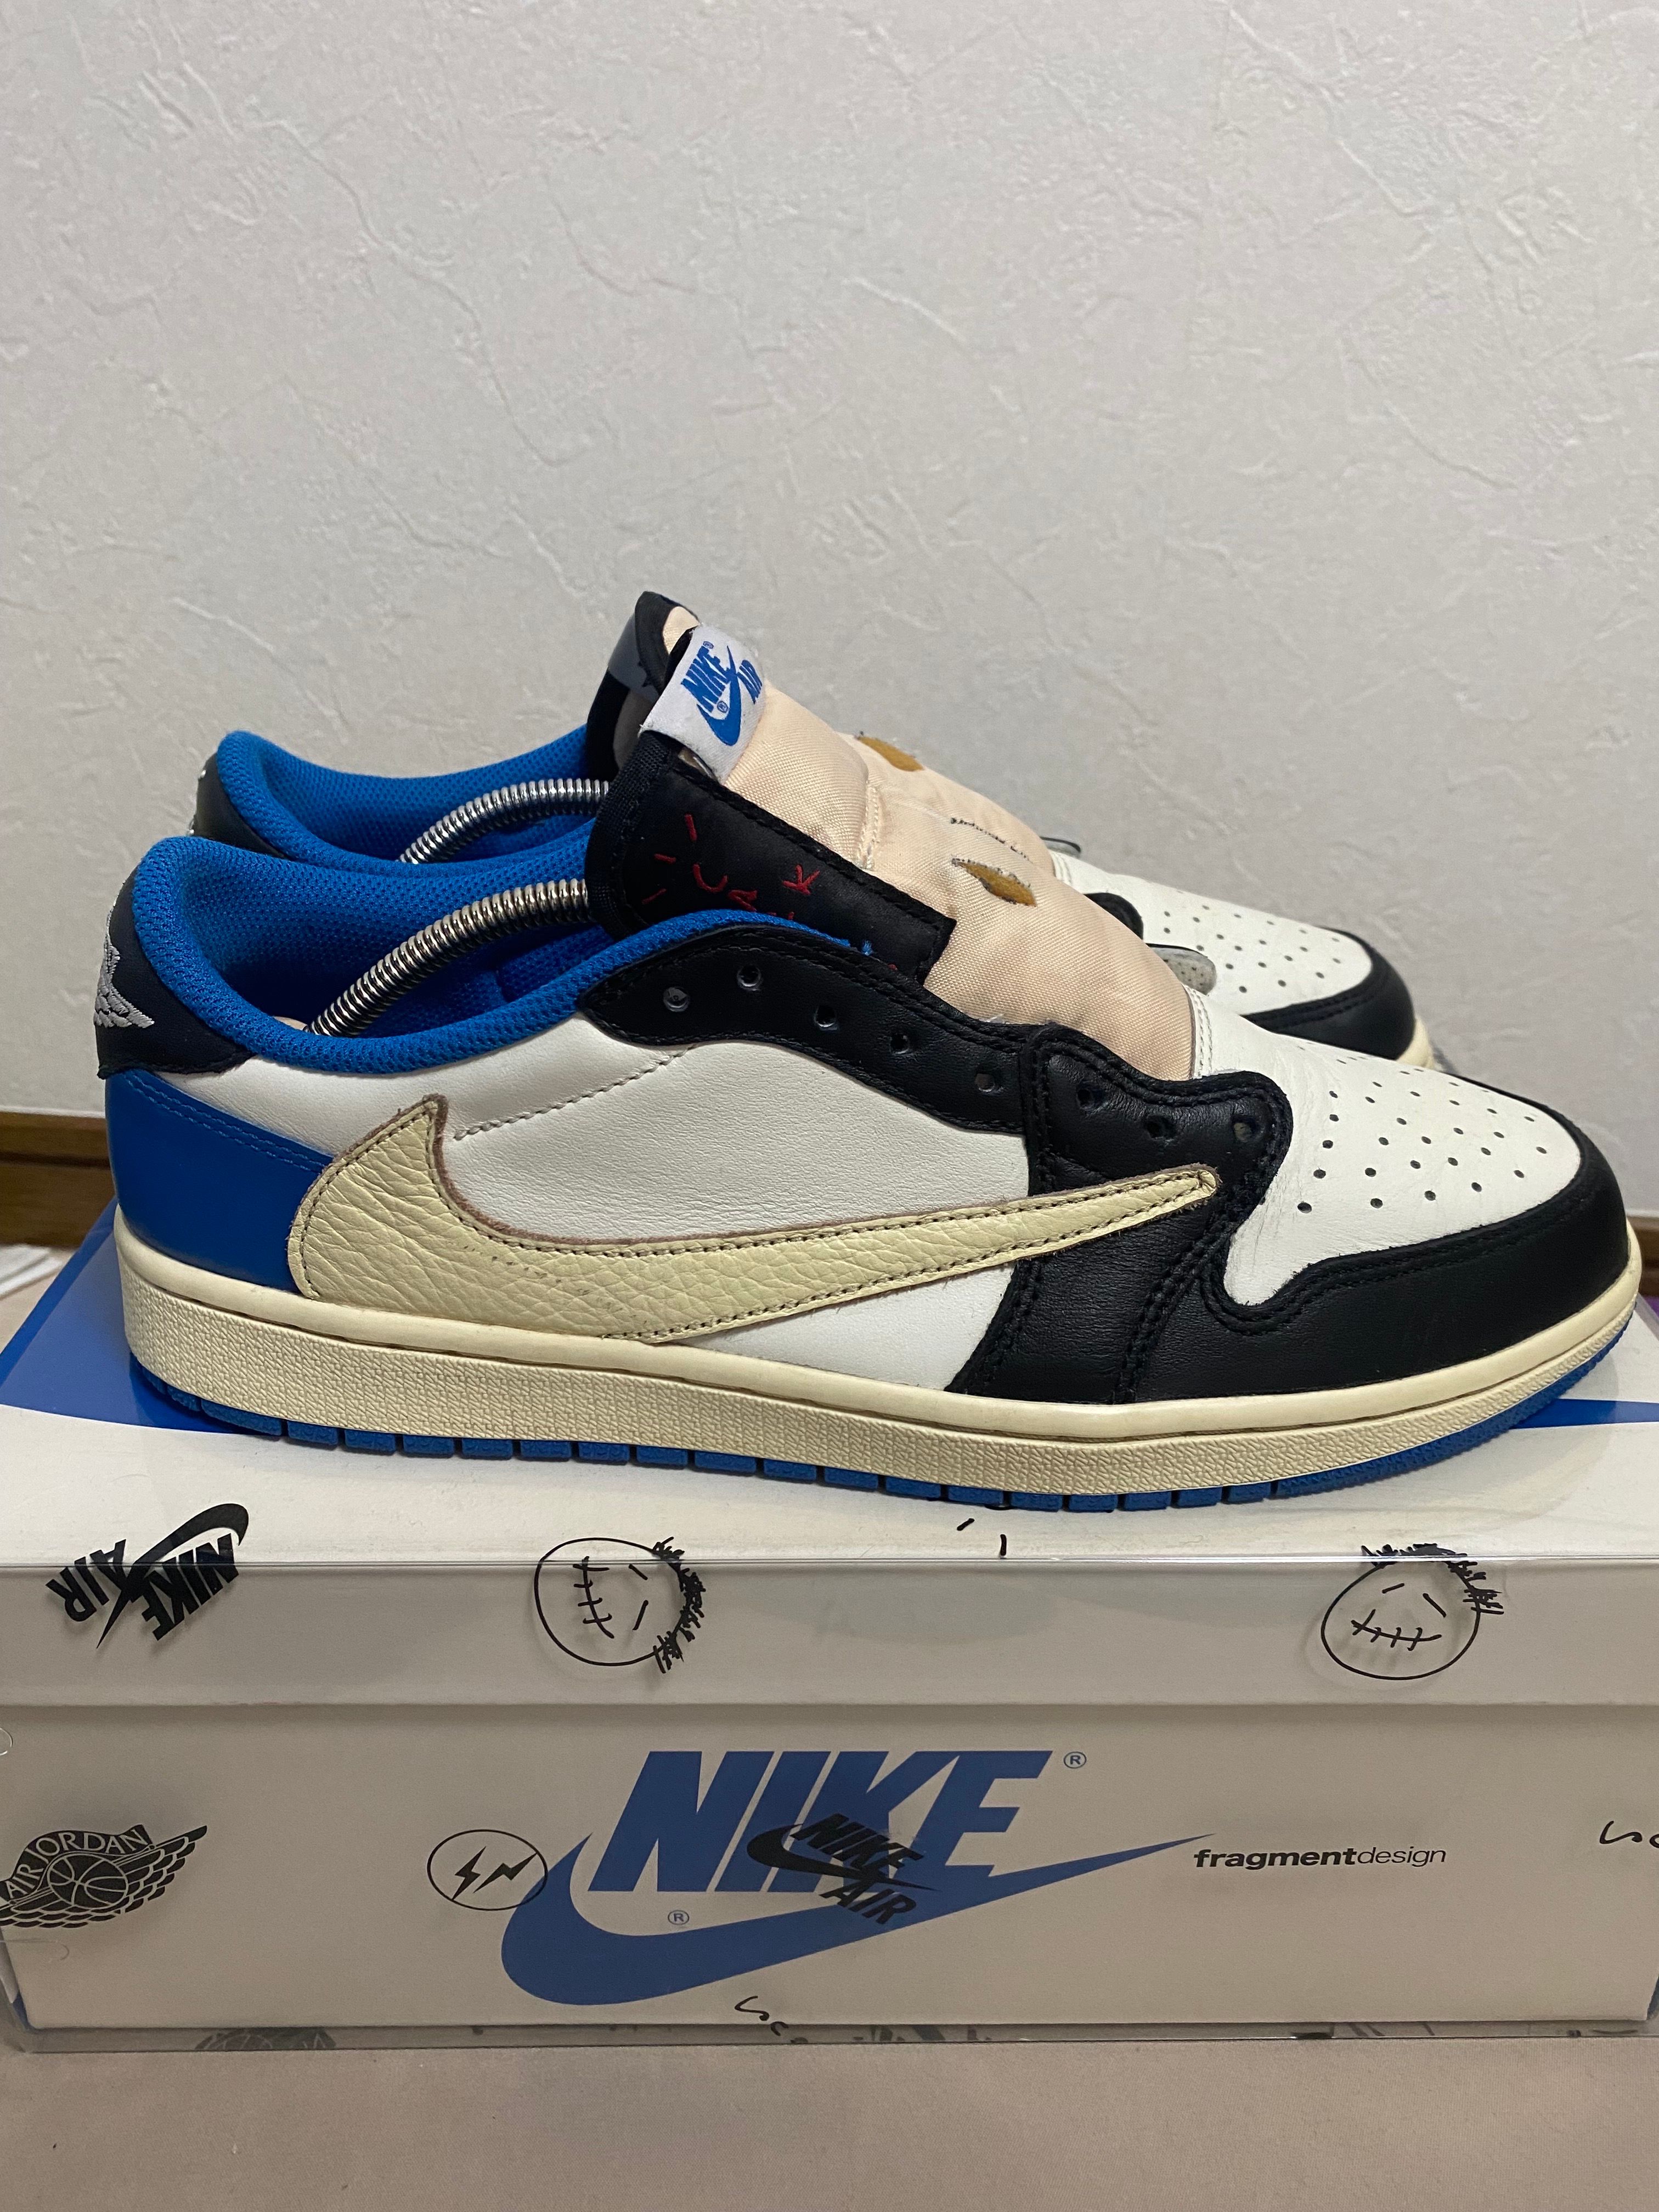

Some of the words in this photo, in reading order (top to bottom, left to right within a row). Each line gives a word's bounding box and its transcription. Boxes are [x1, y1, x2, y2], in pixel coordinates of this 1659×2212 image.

[681, 646, 731, 713] NIKE
[46, 1539, 137, 1622] AIR
[129, 1533, 239, 1641] NIKE
[588, 1751, 1053, 1892] NIKE
[789, 1813, 924, 1880] NIKE
[4, 1864, 44, 1899] AIR
[25, 1829, 149, 1865] JORDAN
[1193, 1846, 1447, 1870] fragmentdesign
[819, 1878, 917, 1925] AIR
